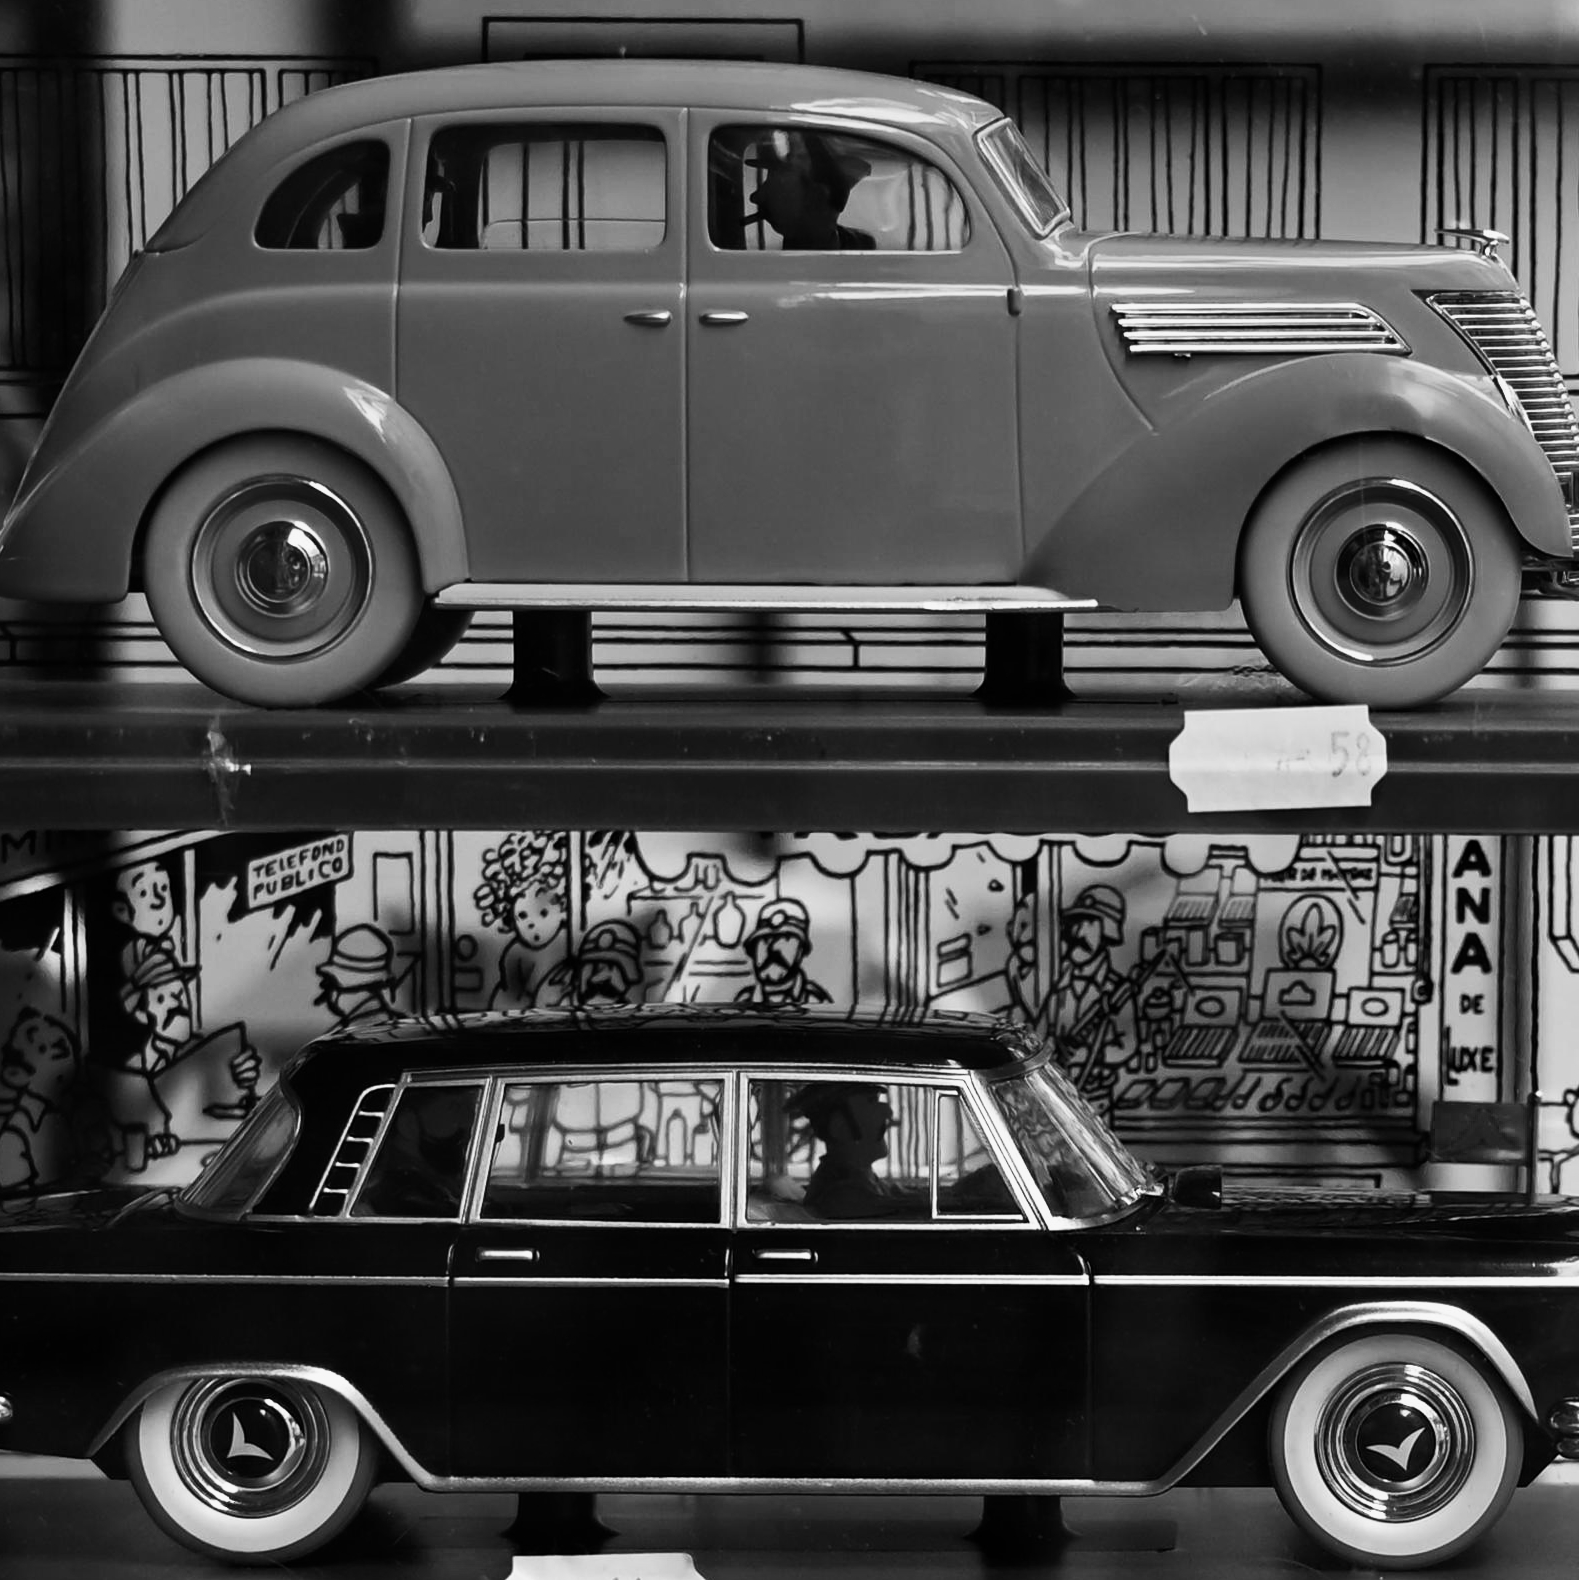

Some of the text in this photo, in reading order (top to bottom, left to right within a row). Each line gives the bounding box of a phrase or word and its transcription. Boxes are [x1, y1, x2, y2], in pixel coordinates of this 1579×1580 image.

[253, 856, 343, 901] PUBLICO
[1451, 838, 1493, 974] ANA
[1459, 993, 1484, 1015] DE
